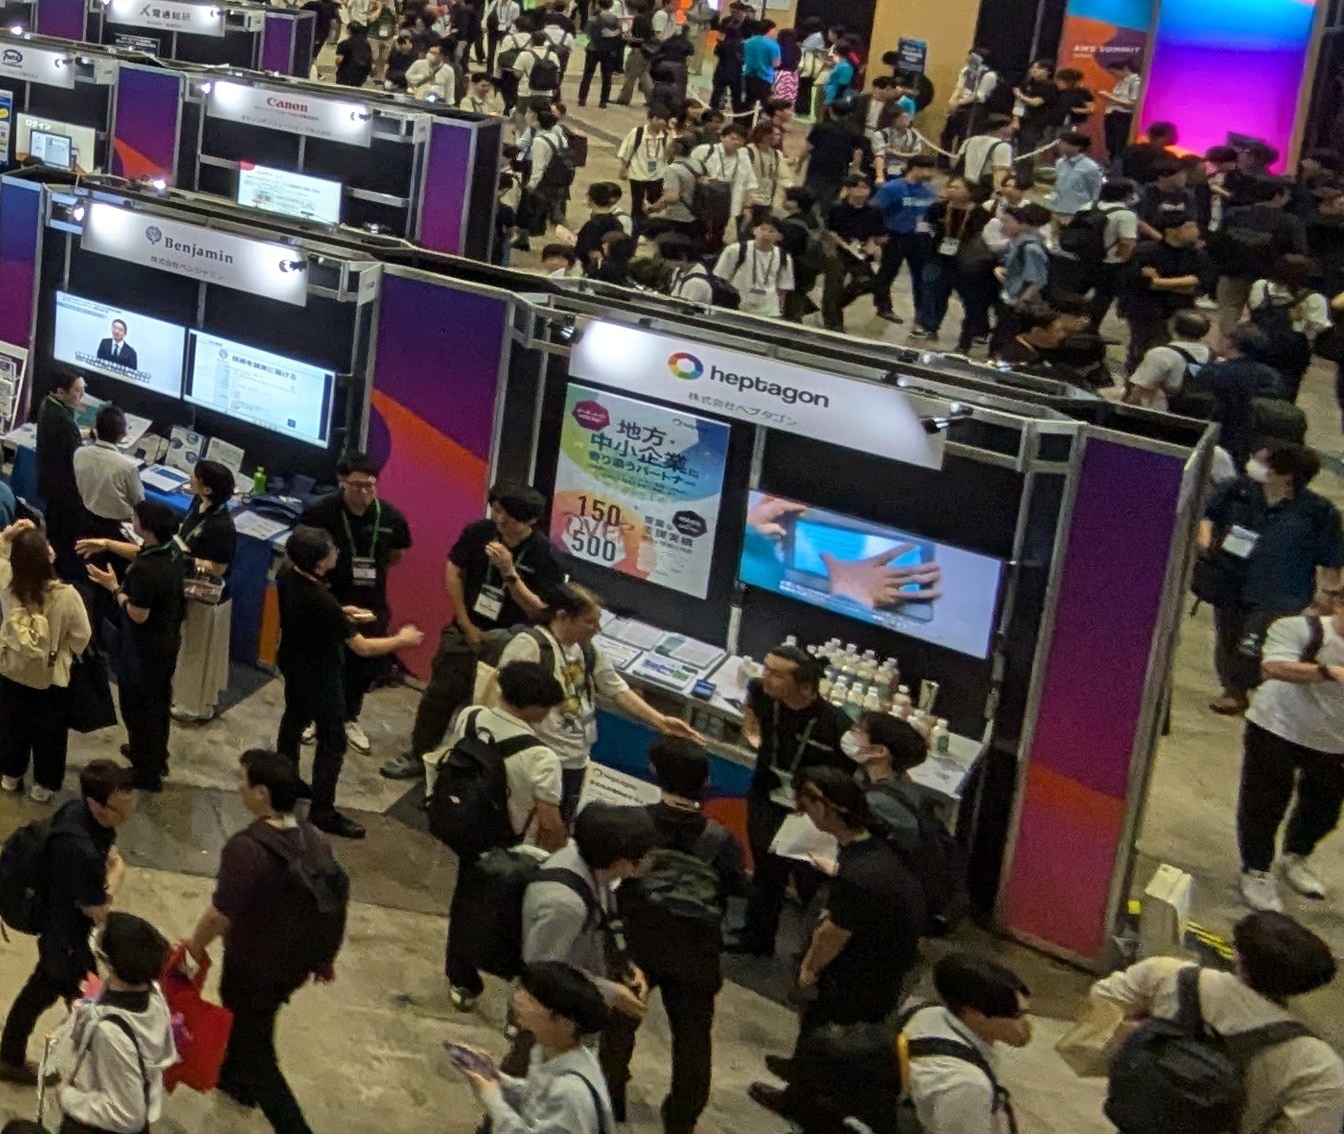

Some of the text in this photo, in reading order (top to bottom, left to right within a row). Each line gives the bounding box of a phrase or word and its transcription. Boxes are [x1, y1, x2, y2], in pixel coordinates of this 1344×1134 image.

[266, 97, 309, 113] Canon
[24, 118, 51, 131] ログイン
[164, 236, 234, 264] Benjamin
[710, 365, 829, 408] heptagon
[688, 391, 798, 426] 株式会社ヘプタゴン
[577, 495, 621, 527] 150
[571, 530, 617, 563] 500
